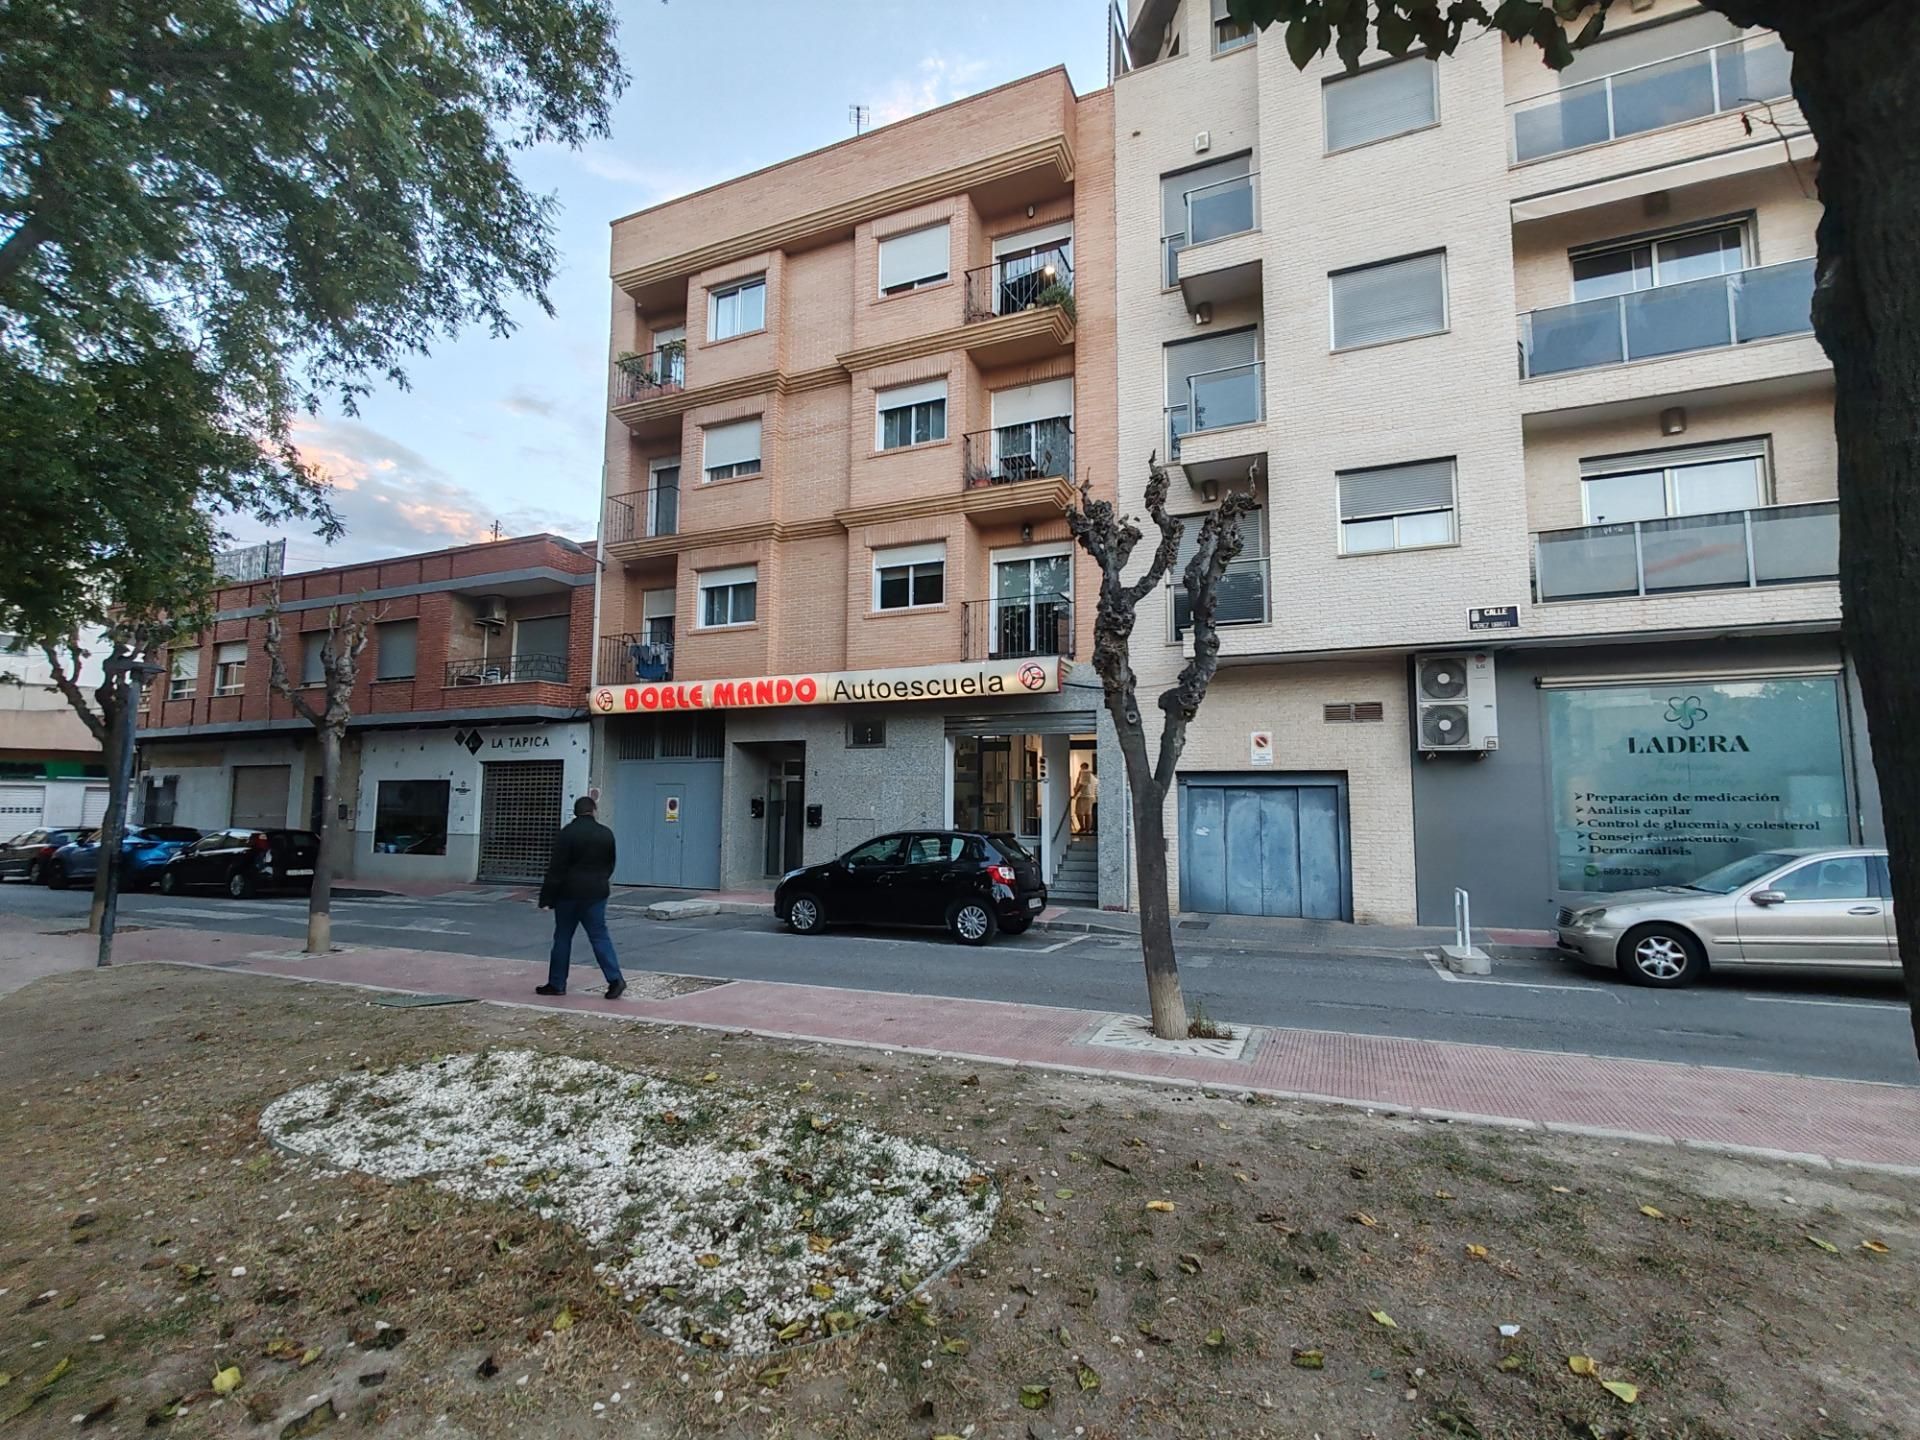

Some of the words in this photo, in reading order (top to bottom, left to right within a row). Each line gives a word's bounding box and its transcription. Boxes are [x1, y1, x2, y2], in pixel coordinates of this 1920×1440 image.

[1484, 608, 1508, 616] CALLE
[624, 685, 704, 710] DOBLE
[713, 678, 817, 706] MANDO
[833, 672, 1004, 700] Autoescuela
[491, 738, 503, 748] LA
[509, 736, 549, 748] TAPICA
[1628, 735, 1750, 753] LADERA
[1586, 792, 1668, 804] Preparación
[1673, 793, 1690, 802] de
[1694, 792, 1780, 802] medicación
[1587, 806, 1641, 815] Análisis
[1644, 806, 1691, 817] capilar
[1587, 819, 1639, 828] Control
[1643, 820, 1660, 828] de
[1664, 820, 1729, 831] glucemia
[1734, 822, 1742, 831] y
[1746, 821, 1820, 831] colesterol
[1588, 832, 1643, 843] Consejo
